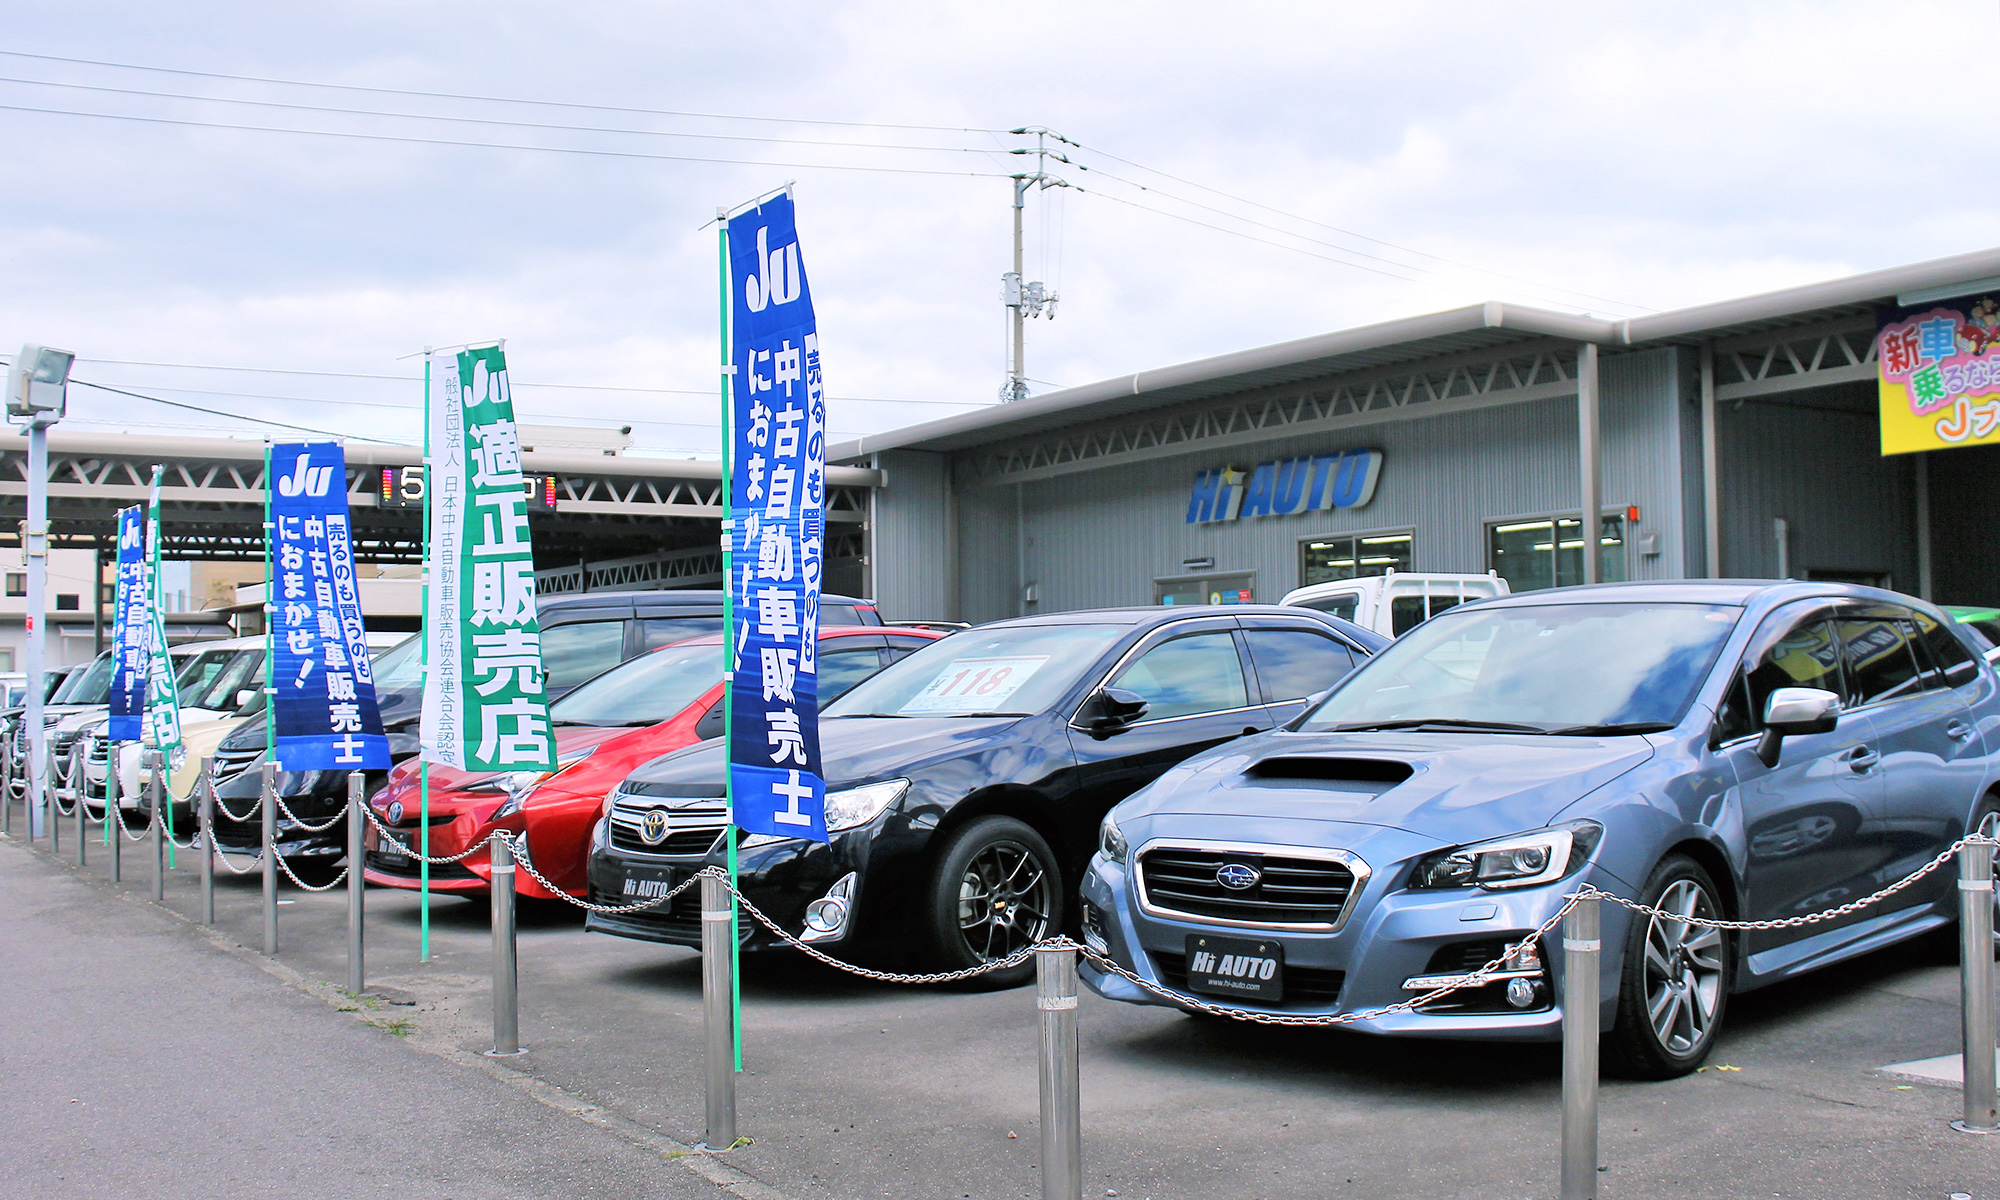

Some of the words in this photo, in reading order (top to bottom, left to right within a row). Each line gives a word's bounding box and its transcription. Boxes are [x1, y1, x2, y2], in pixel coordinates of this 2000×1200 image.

[1884, 316, 1957, 374] 新車
[444, 365, 460, 468] 一般社団法人
[278, 453, 334, 497] Ju
[1186, 464, 1246, 524] Hi
[1240, 447, 1382, 518] AUTO
[278, 515, 316, 689] におまかせ!
[327, 523, 370, 679] 売るのも買うのも
[436, 475, 459, 766] 日本中古自動車販売協会連合会認定
[467, 417, 550, 765] 適正販売店
[757, 339, 813, 827] 中古自動車販売士
[304, 515, 365, 763] 中古自動車販売士
[939, 667, 1013, 696] 118
[623, 878, 637, 895] Hi
[636, 880, 668, 899] AUTO
[1191, 951, 1217, 973] Hi
[1217, 954, 1277, 980] AUTO
[1208, 979, 1260, 991] www.hi-auto.com
